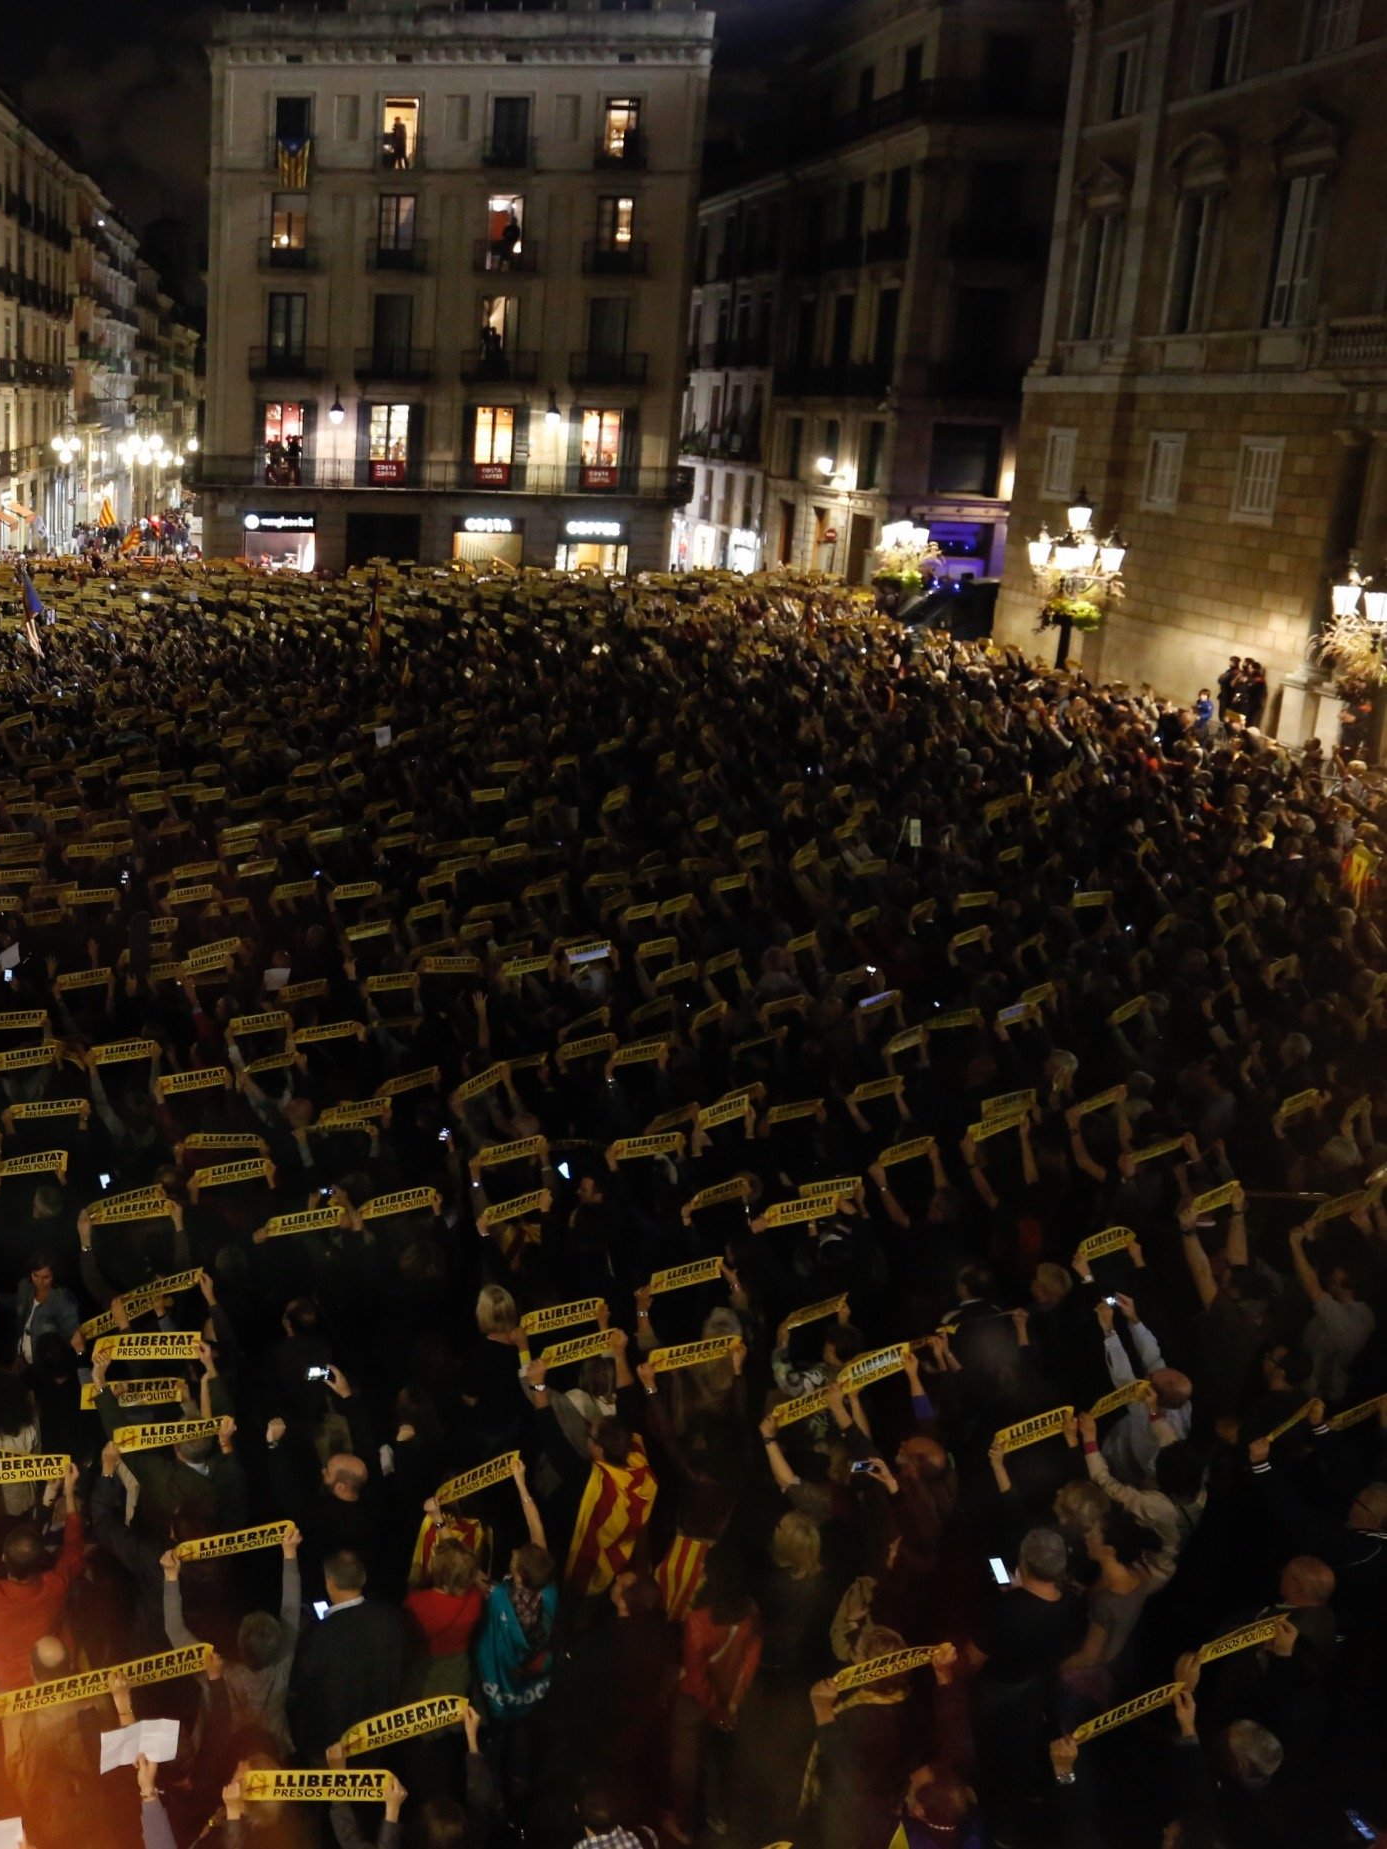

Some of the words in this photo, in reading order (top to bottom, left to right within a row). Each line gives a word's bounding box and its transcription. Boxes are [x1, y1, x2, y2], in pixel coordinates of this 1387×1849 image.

[465, 517, 512, 532] COSTA
[173, 1067, 225, 1085] LLIBERTAT
[26, 1100, 82, 1113] LLIBERTAT
[336, 1100, 386, 1117] LLIBERTAT
[492, 1139, 540, 1157] LLIBERTAT
[627, 1135, 676, 1148] LLIBERTAT
[212, 1160, 264, 1174] LLIBERTAT
[373, 1189, 429, 1207] LLIBERTAT
[496, 1192, 541, 1214] LLIBERTAT
[780, 1199, 831, 1214] LLIBERTAT
[105, 1201, 169, 1216] LLIBERTAT
[281, 1209, 340, 1228] LLIBERTAT
[667, 1260, 717, 1279] LLIBERTAT
[137, 1272, 198, 1294] LLIBERTAT
[538, 1301, 597, 1321] LLIBERTAT
[118, 1334, 194, 1347] LLIBERTAT
[556, 1331, 613, 1355] LLIBERTAT
[668, 1338, 732, 1358] LLIBERTAT
[117, 1348, 151, 1357] PRESOS
[851, 1347, 903, 1375] LLIBERTAT
[141, 1419, 223, 1439] LLIBERTAT
[1010, 1409, 1066, 1438] LLIBERTAT
[140, 1435, 176, 1445] PRESOS
[454, 1455, 512, 1488] LLIBERTAT
[200, 1524, 288, 1551] LLIBERTAT
[200, 1546, 239, 1559] PRESOS
[14, 1672, 109, 1701] LLIBERTAT
[13, 1695, 56, 1711] PRESOS
[1094, 1685, 1173, 1730] LLIBERTAT
[367, 1698, 459, 1737] LLIBERTAT
[367, 1728, 411, 1748] PRESOS
[274, 1773, 385, 1788] LLIBERTAT
[273, 1788, 324, 1798] PRESOS
